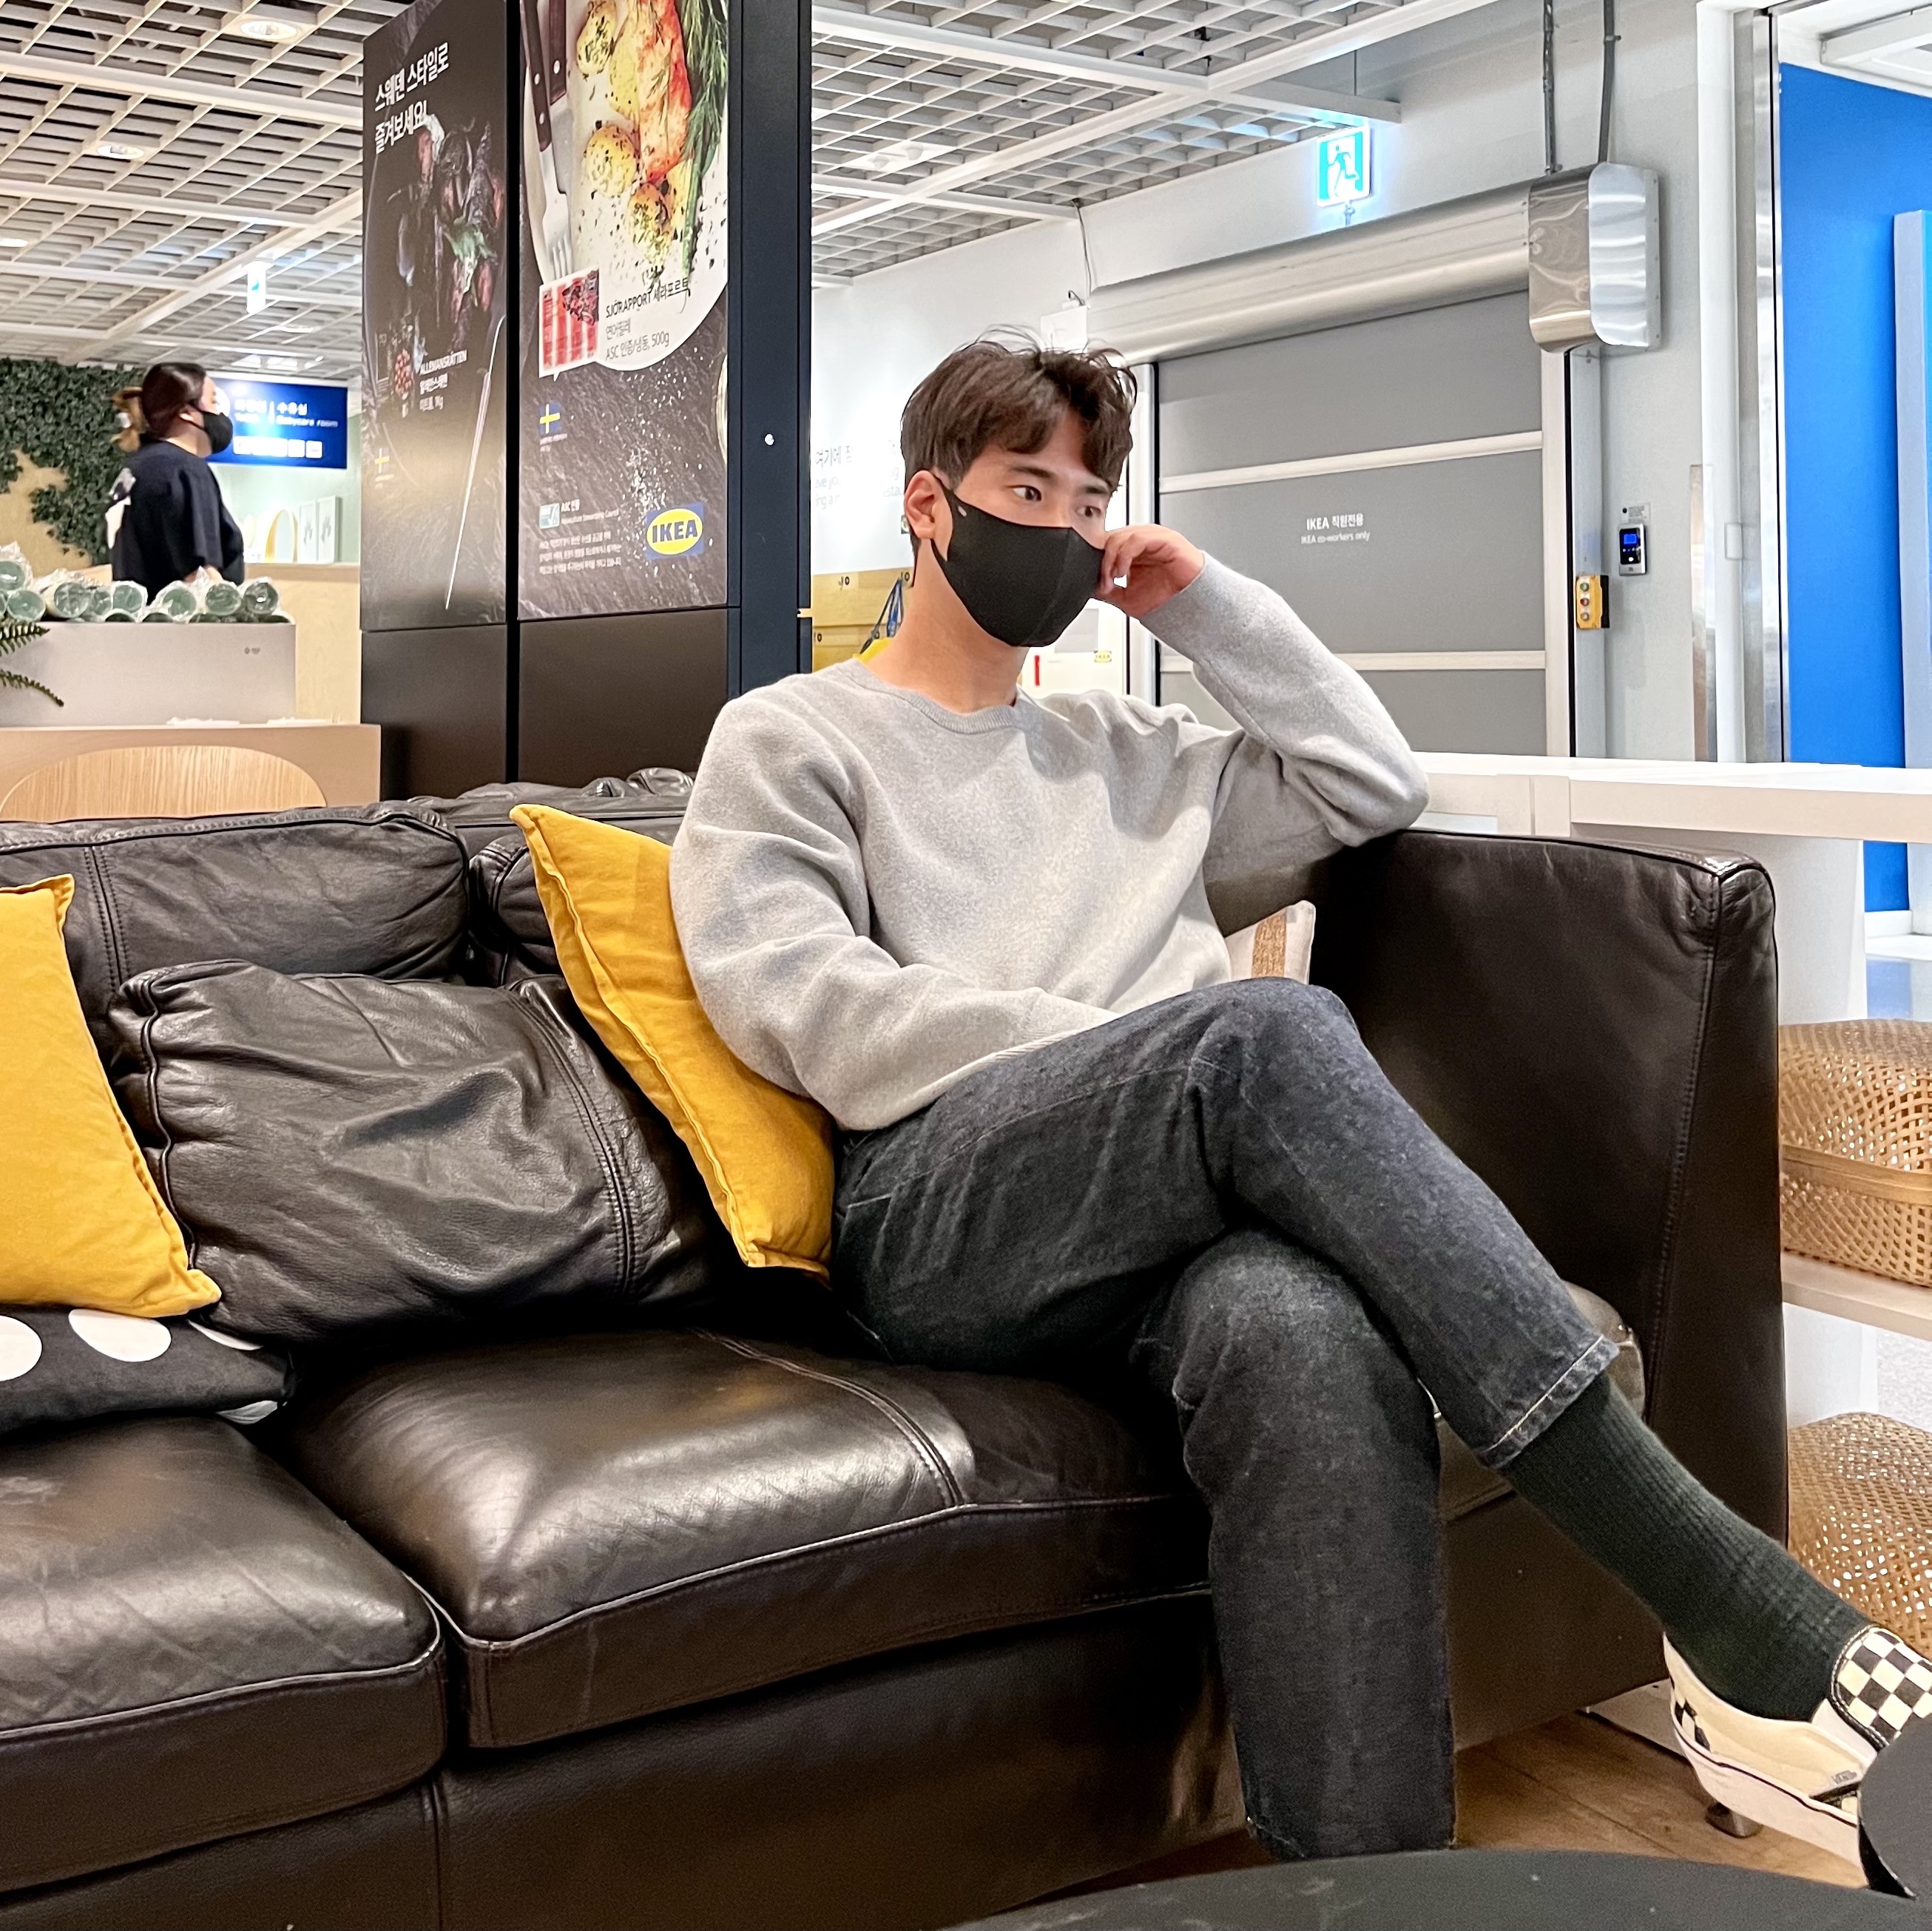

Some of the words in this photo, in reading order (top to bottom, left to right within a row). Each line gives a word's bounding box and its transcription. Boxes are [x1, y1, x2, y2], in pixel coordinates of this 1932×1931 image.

[375, 68, 405, 112] 스웨덴
[407, 42, 449, 92] 스타일로
[606, 343, 621, 361] ASC
[651, 331, 669, 348] 500g
[652, 519, 698, 544] IKEA
[1306, 516, 1330, 531] IKEA
